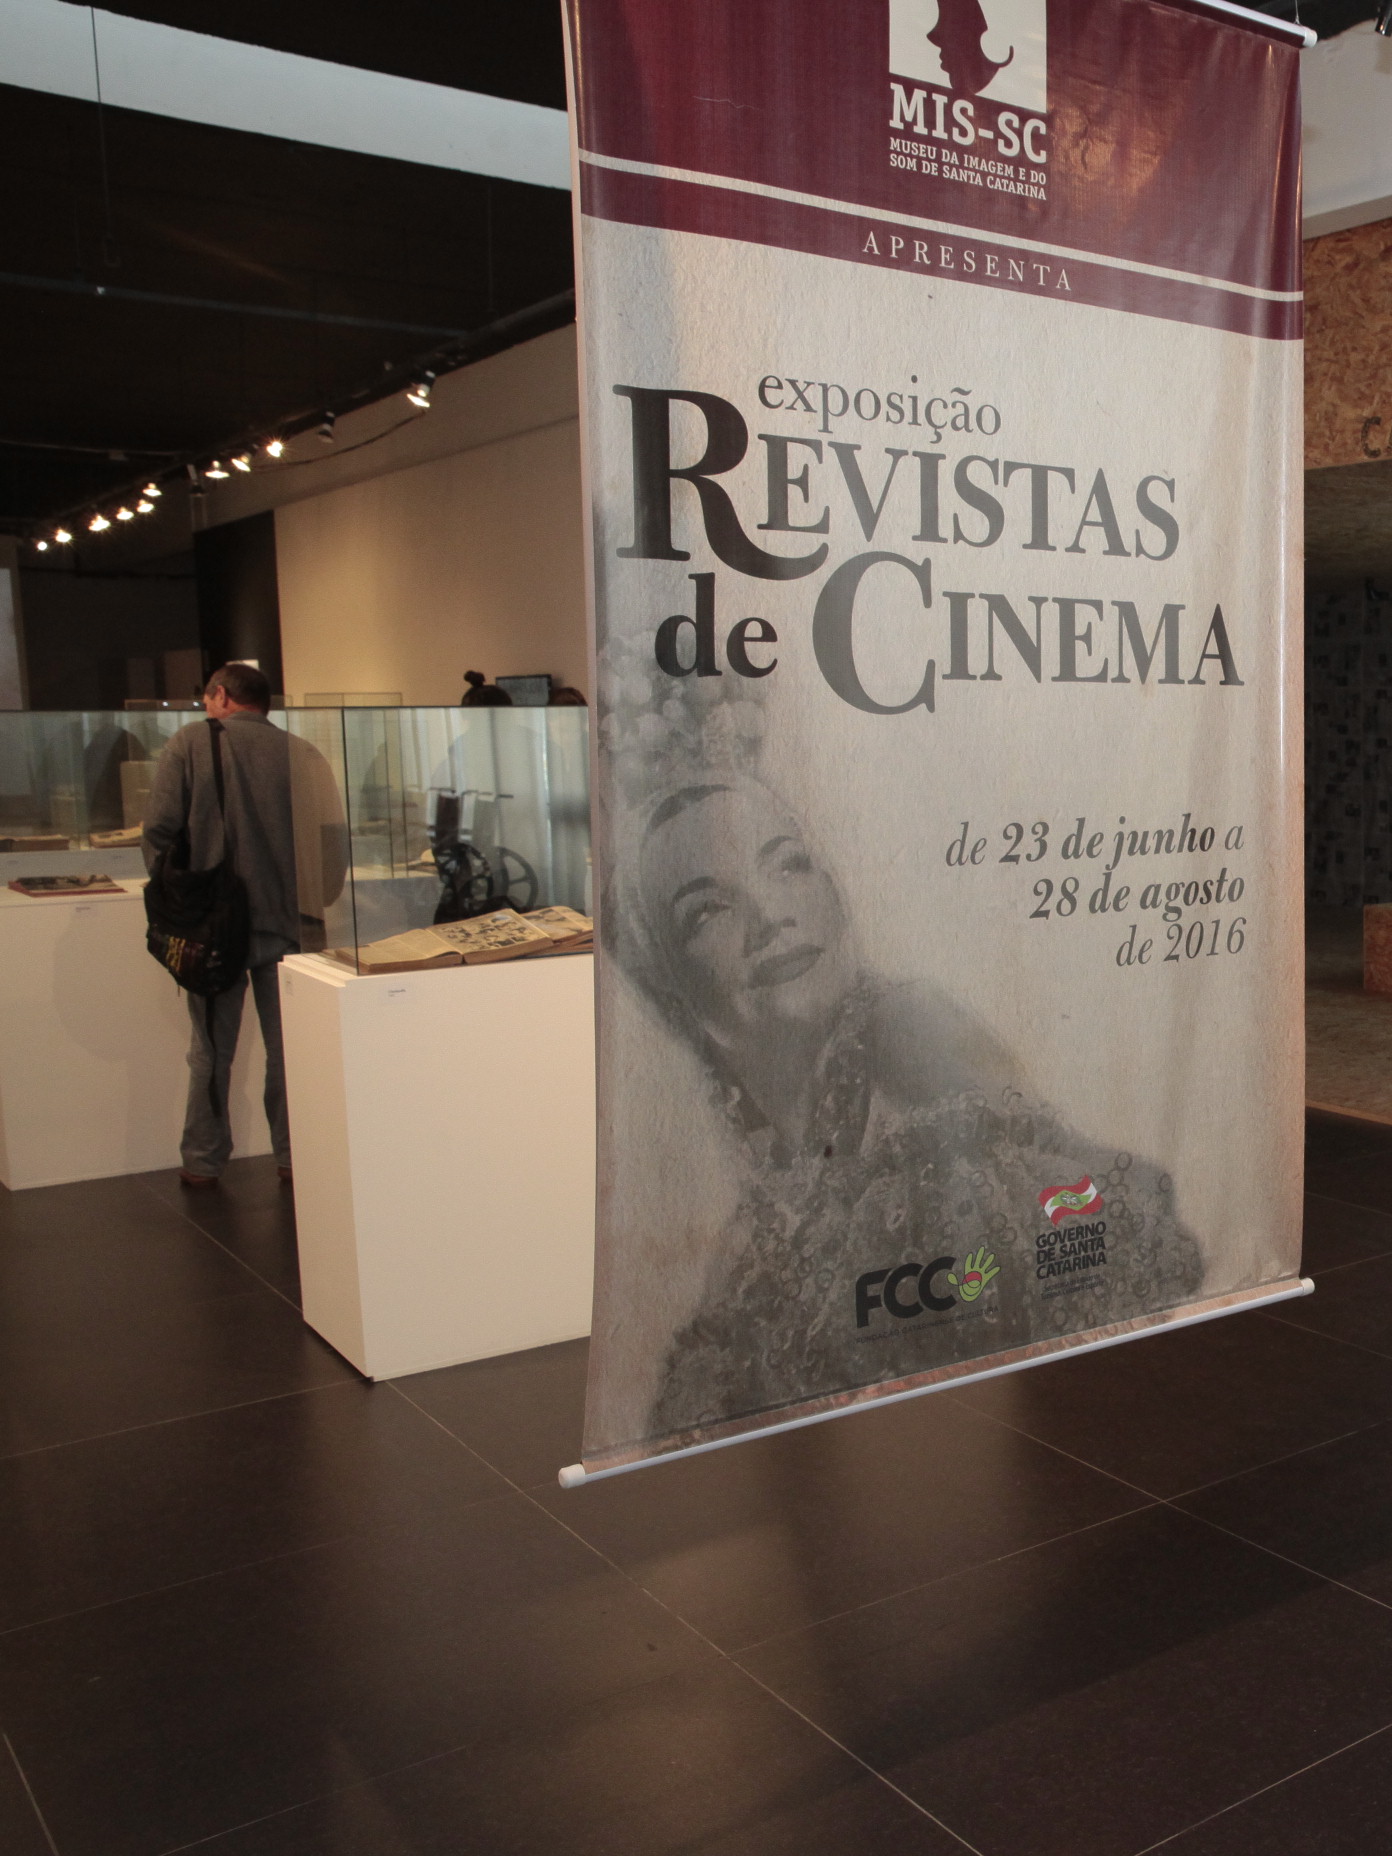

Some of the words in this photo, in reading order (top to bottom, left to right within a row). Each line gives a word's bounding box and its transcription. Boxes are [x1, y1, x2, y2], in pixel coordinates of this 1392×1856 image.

[889, 82, 1047, 163] MIS-SC
[890, 137, 937, 159] MUSEU
[942, 149, 959, 165] DA
[964, 154, 1014, 178] IMAGEM
[1019, 168, 1025, 180] E
[1030, 170, 1046, 185] DO
[890, 154, 917, 171] SOM
[922, 161, 938, 176] DE
[943, 166, 982, 186] SANTA
[987, 176, 1047, 200] CATARINA
[863, 231, 1071, 290] APRESENTA
[758, 375, 1001, 444] exposição
[612, 384, 1181, 581] REVISTAS
[654, 572, 779, 678] de
[812, 551, 1245, 715] CINEMA
[946, 821, 987, 866] de
[999, 821, 1049, 865] 23
[1062, 817, 1104, 859] de
[1105, 813, 1215, 871] junho
[1225, 826, 1244, 850] a
[1029, 877, 1079, 920] 28
[1089, 872, 1130, 914] de
[1140, 868, 1244, 922] agosto
[1116, 924, 1153, 966] de
[1163, 917, 1246, 962] 2016
[1036, 1221, 1106, 1248] GOVERNO
[1037, 1247, 1055, 1264] DE
[1060, 1237, 1106, 1259] SANTA
[856, 1256, 957, 1328] FCC
[1036, 1252, 1107, 1279] CATARINA
